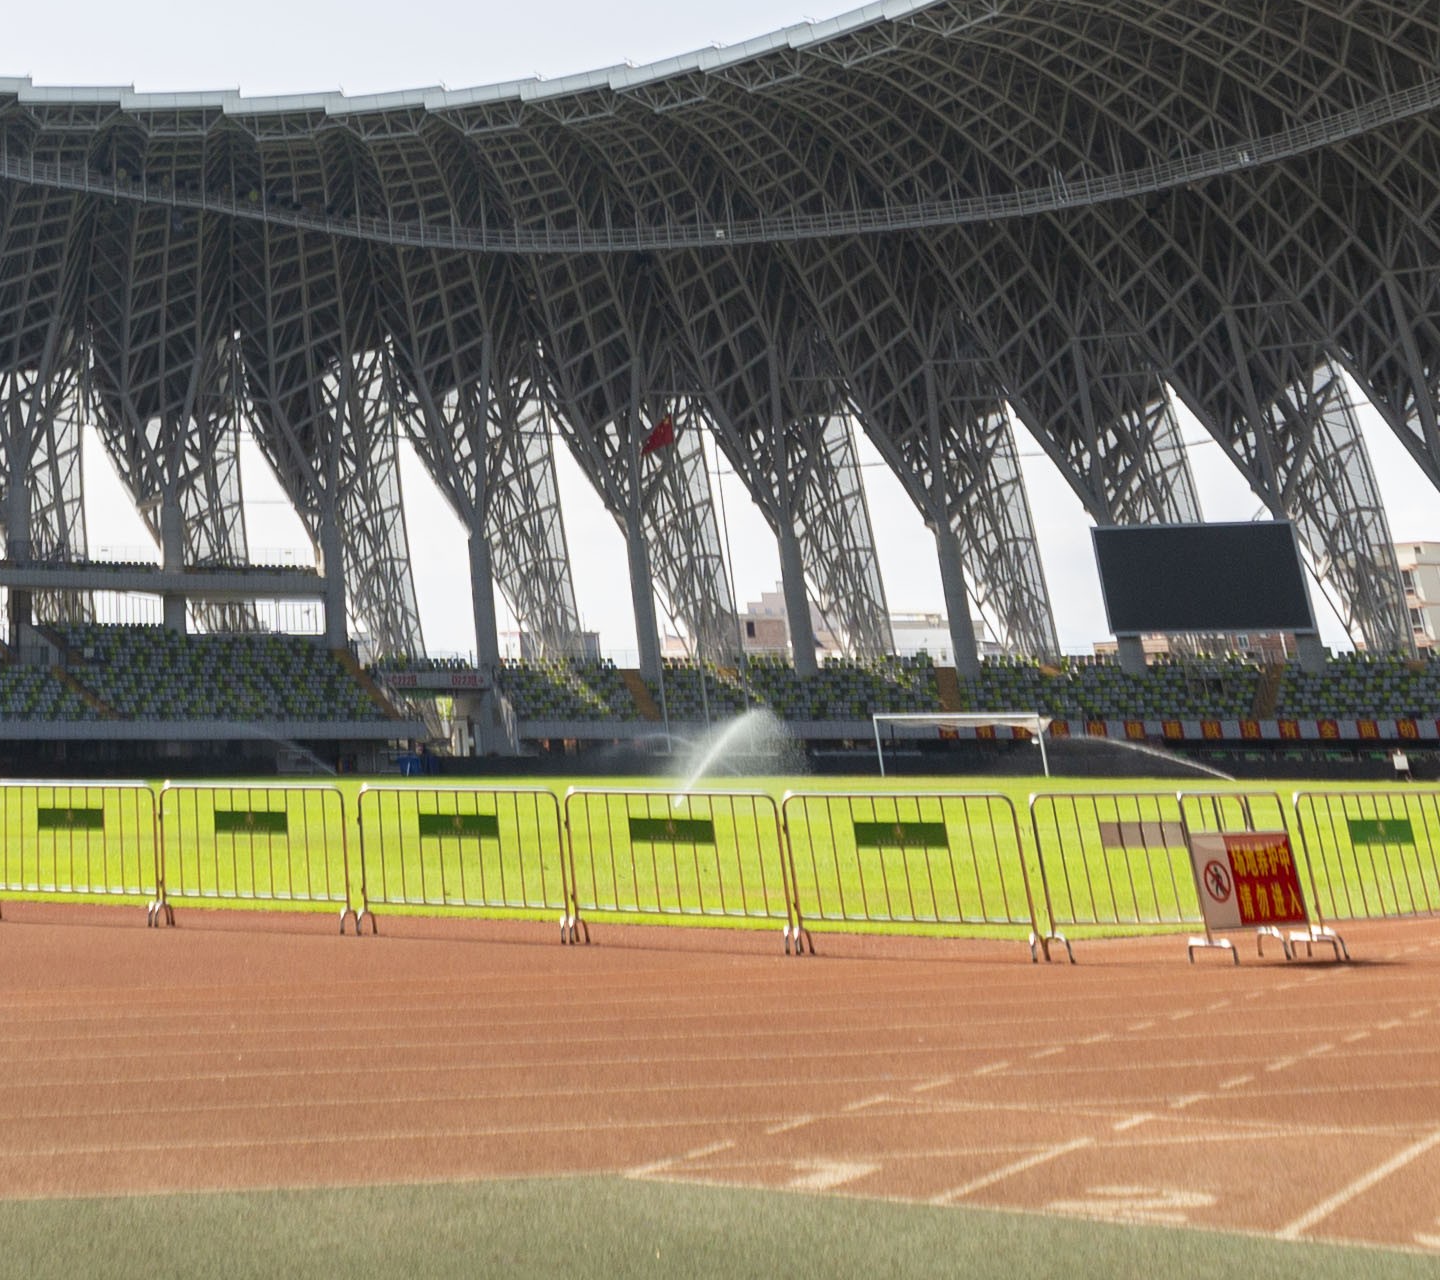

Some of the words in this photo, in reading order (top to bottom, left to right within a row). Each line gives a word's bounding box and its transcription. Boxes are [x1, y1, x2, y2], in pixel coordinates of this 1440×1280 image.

[1230, 842, 1290, 877] 场地养护中
[1239, 882, 1302, 920] 请勿进入
